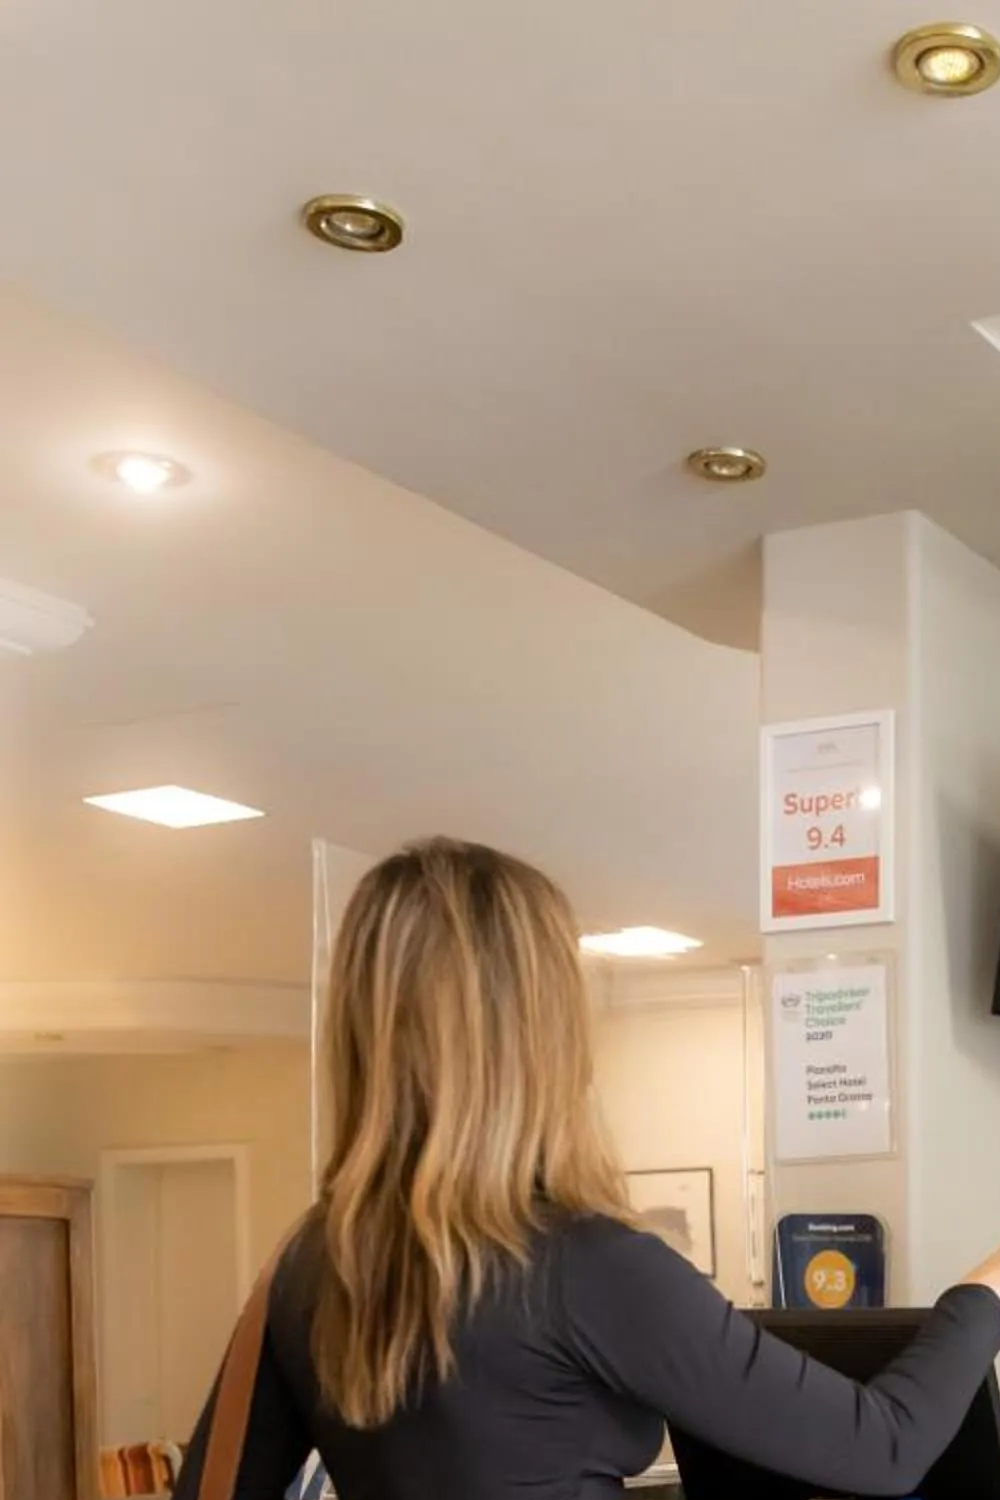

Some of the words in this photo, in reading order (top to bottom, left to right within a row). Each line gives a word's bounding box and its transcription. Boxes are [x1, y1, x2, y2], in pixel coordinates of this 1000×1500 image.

[783, 787, 864, 816] Super
[806, 823, 846, 851] 9.4
[787, 870, 865, 891] Hotels.com
